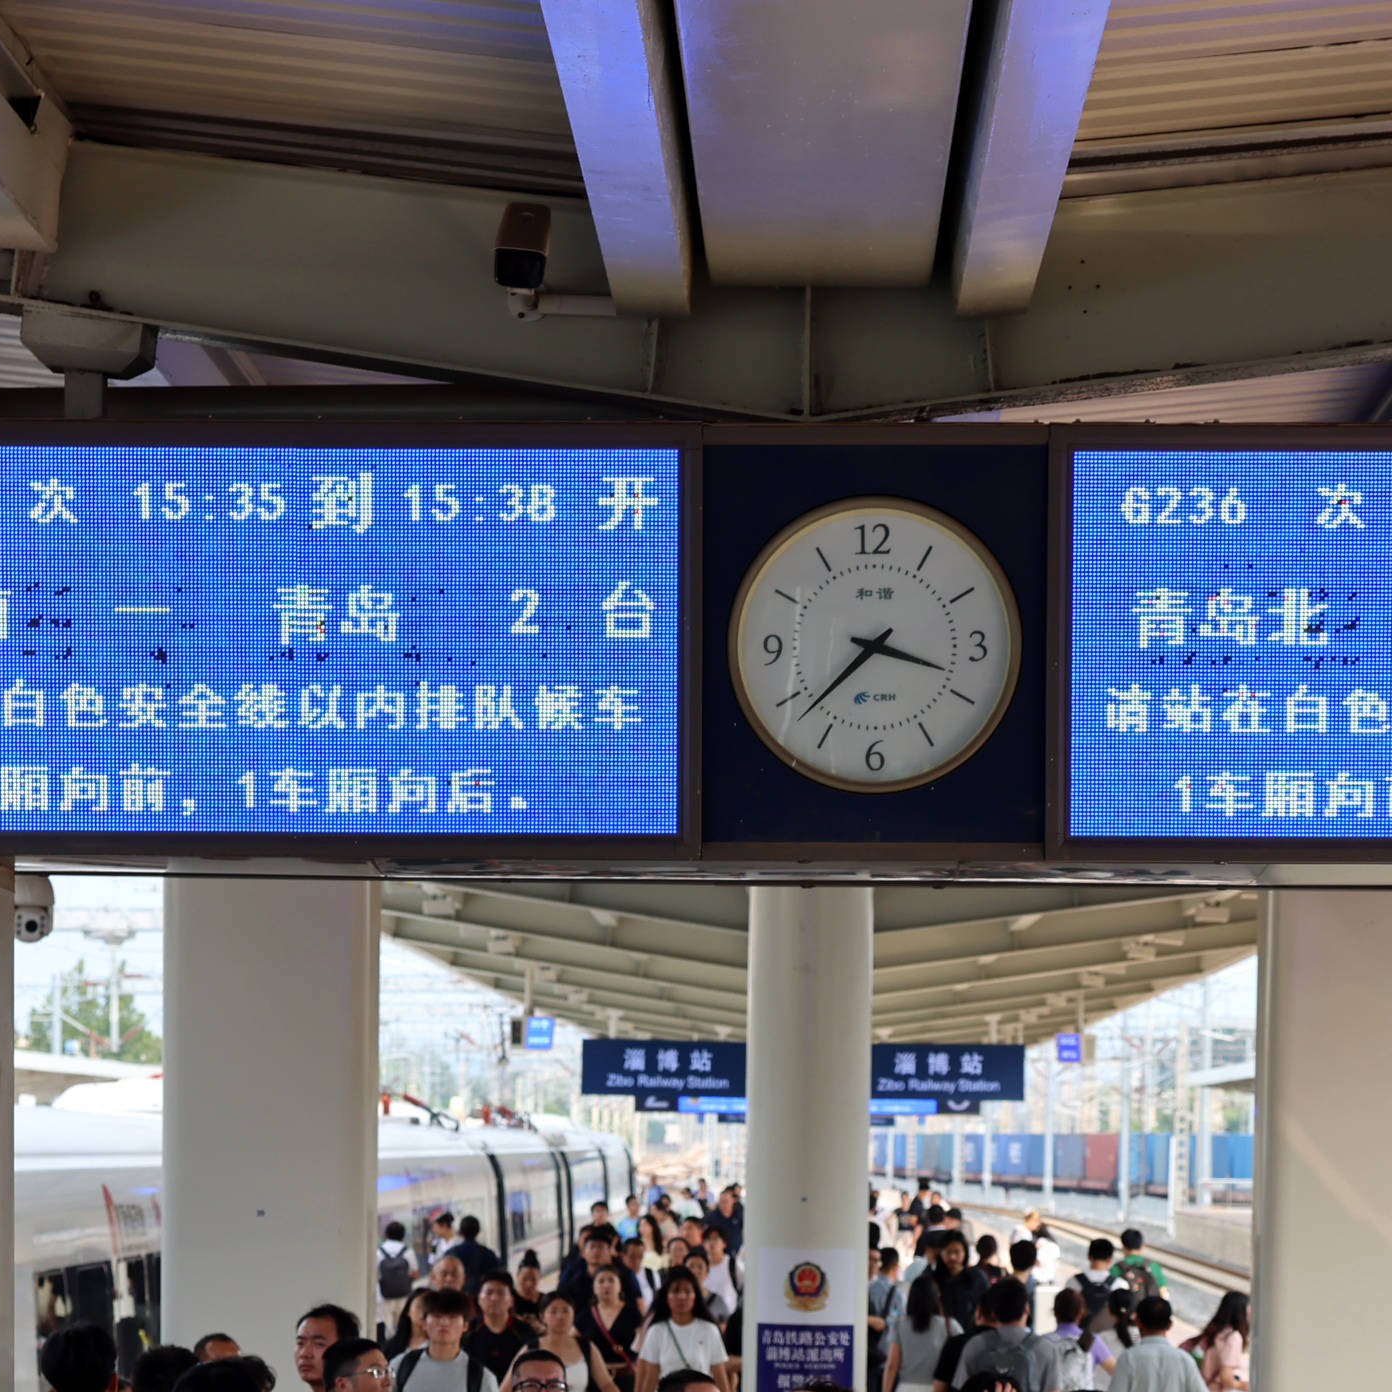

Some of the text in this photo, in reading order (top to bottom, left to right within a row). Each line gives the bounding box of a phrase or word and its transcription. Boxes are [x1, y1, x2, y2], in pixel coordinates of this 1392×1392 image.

[27, 479, 79, 524] 次
[132, 482, 286, 522] 15:35
[310, 471, 375, 534] 到
[403, 483, 557, 524] 15:38
[596, 475, 660, 531] 开
[1120, 486, 1247, 526] G236
[1315, 483, 1366, 529] 次
[853, 522, 892, 556] 12
[854, 587, 895, 601] 和谐
[272, 583, 401, 645] 青岛
[510, 588, 541, 635] 2
[600, 580, 655, 640] 台
[1131, 586, 1330, 649] 青岛北
[762, 633, 783, 667] 9
[968, 630, 988, 663] 3
[873, 693, 896, 702] CRH
[864, 739, 886, 772] 6
[622, 1047, 713, 1072] 淄博站
[894, 1051, 984, 1076] 淄博站
[606, 1072, 730, 1091] Zibo Railway Station
[877, 1077, 1001, 1095] Zibo Railway Station
